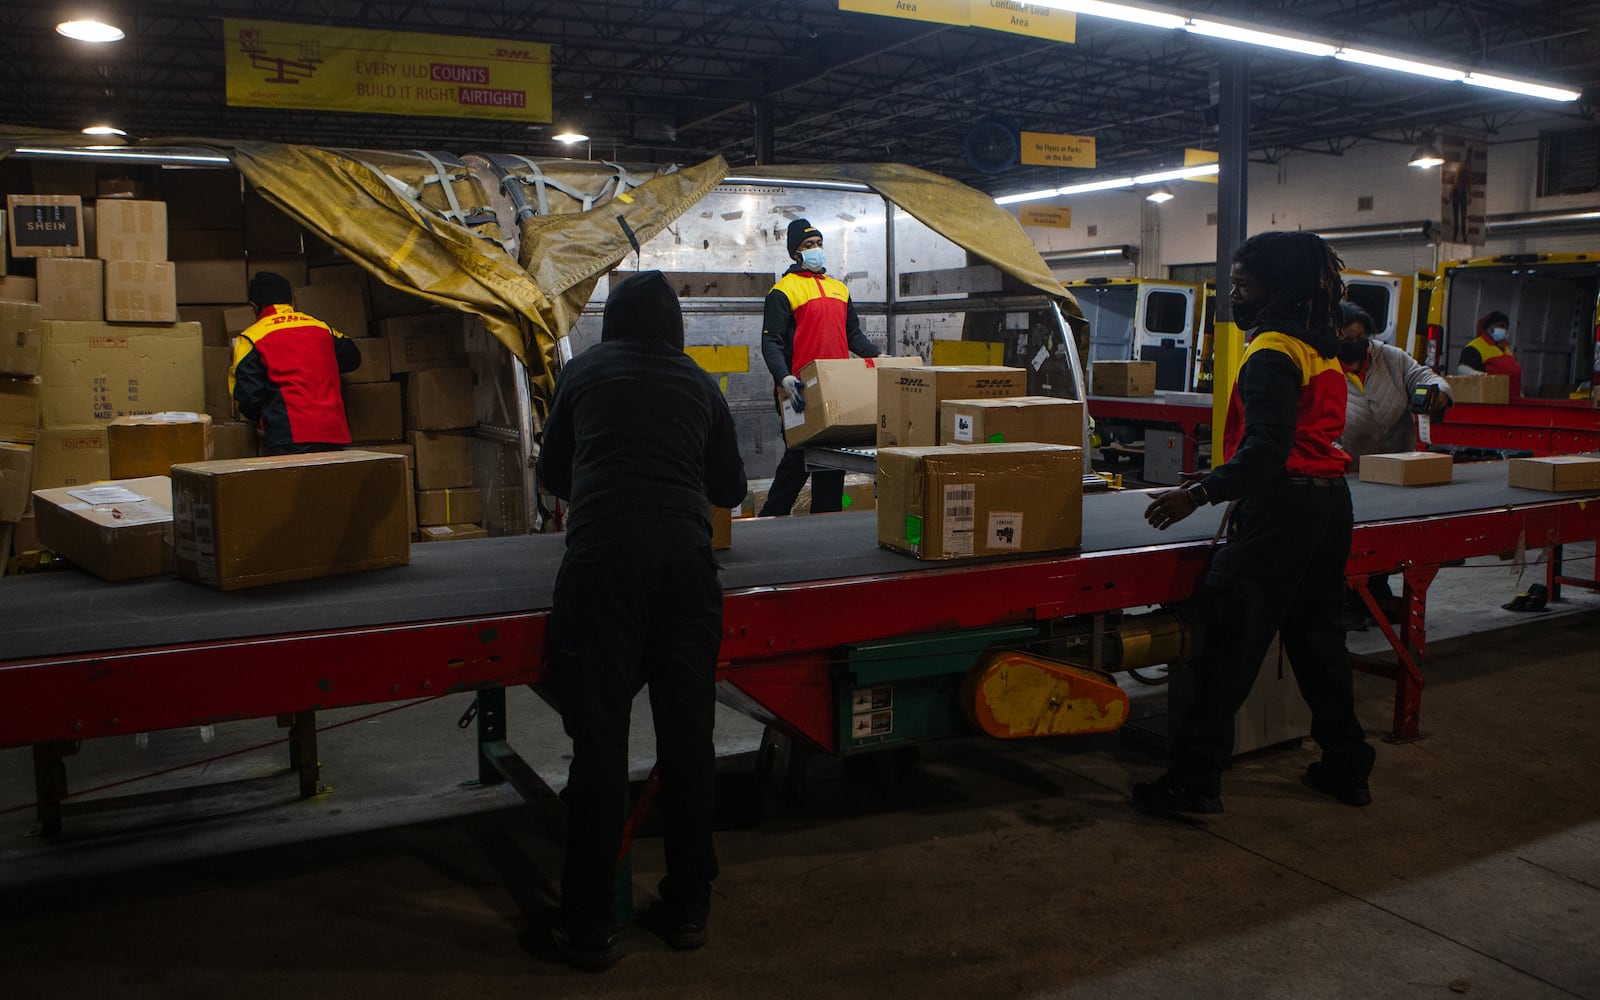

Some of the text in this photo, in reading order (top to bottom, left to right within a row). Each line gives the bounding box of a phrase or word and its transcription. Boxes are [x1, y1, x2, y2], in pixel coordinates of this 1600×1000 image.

[896, 0, 917, 11] Area
[990, 0, 1050, 16] Container Load
[1010, 15, 1029, 27] Area
[356, 61, 486, 83] EVERY ULD COUNTS
[357, 82, 396, 98] BUILD
[400, 86, 411, 99] IT
[460, 88, 525, 106] AIRTIGHT!
[1035, 143, 1044, 151] No
[26, 221, 66, 231] SHEIN
[900, 377, 924, 387] DHL
[975, 379, 1013, 388] DHL
[94, 411, 113, 420] MADE
[881, 414, 887, 429] 8
